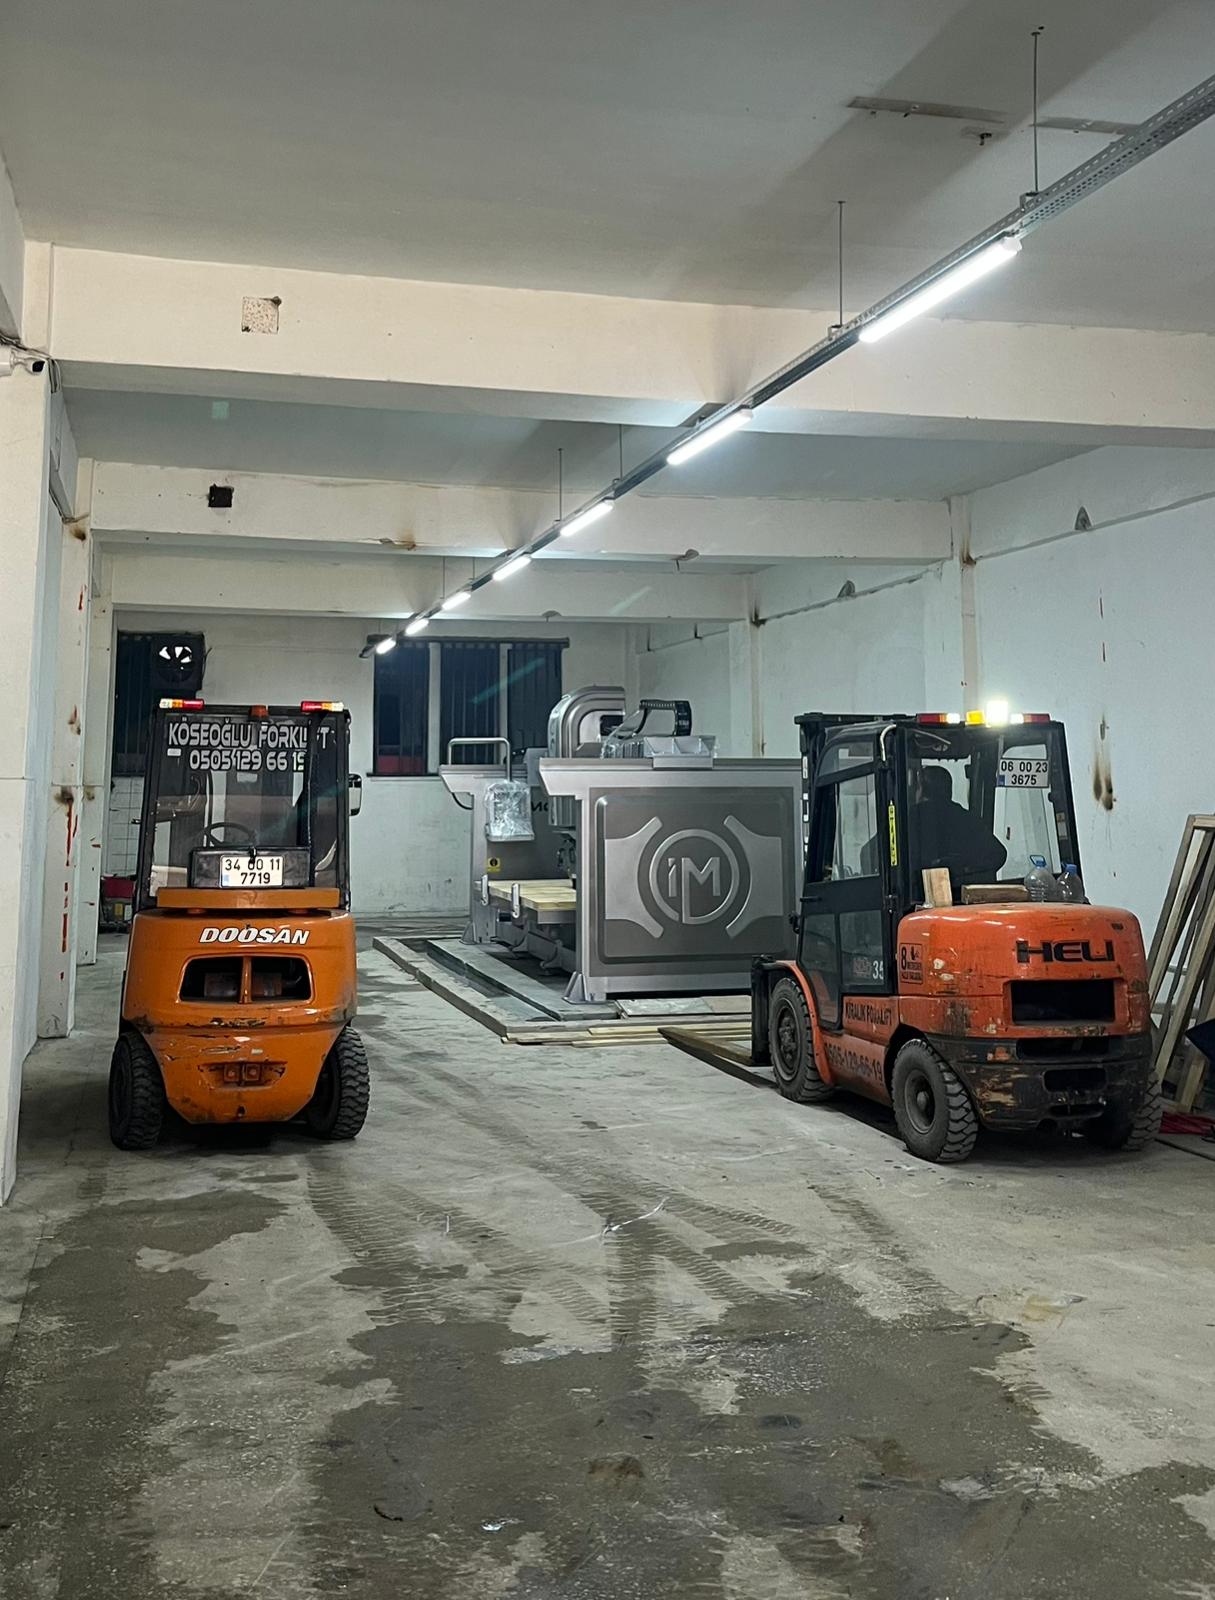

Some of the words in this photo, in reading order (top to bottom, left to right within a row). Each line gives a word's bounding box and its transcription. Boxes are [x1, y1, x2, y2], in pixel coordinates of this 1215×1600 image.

[168, 717, 252, 747] KÖSEOĞLU
[189, 749, 231, 770] 0505
[234, 750, 262, 770] 129
[266, 751, 288, 771] 66
[1001, 761, 1014, 772] 06
[1019, 761, 1032, 773] 00
[1035, 762, 1048, 773] 23
[1011, 774, 1037, 786] 3675
[225, 858, 241, 871] 34
[270, 858, 280, 871] 11
[240, 872, 271, 885] 7719
[199, 926, 310, 945] DOOSAN
[901, 946, 907, 971] 8
